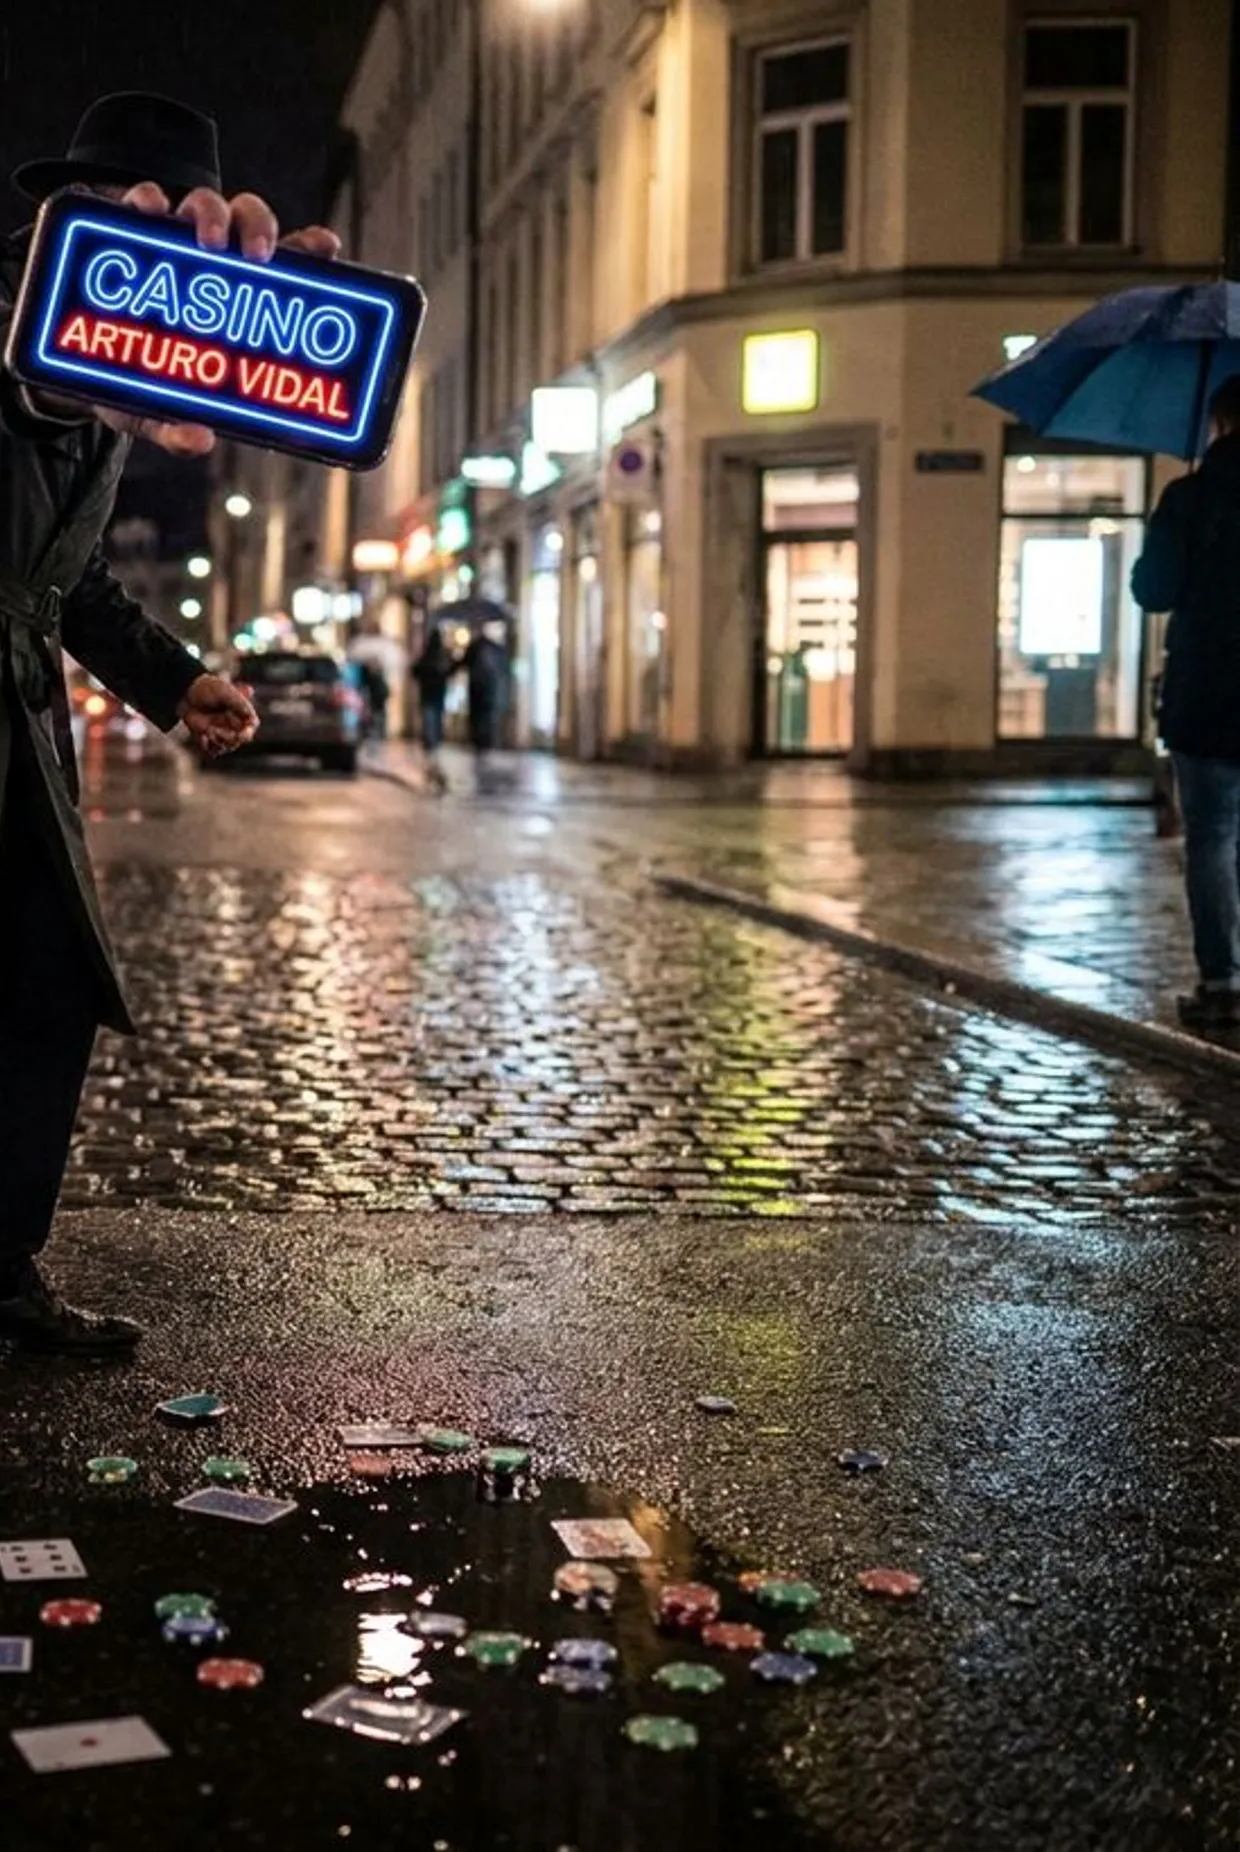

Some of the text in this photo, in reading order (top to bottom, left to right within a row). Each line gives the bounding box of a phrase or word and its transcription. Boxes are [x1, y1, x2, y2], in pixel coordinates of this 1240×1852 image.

[85, 250, 357, 365] CASINO
[60, 316, 350, 420] ARTURO VIDAL
